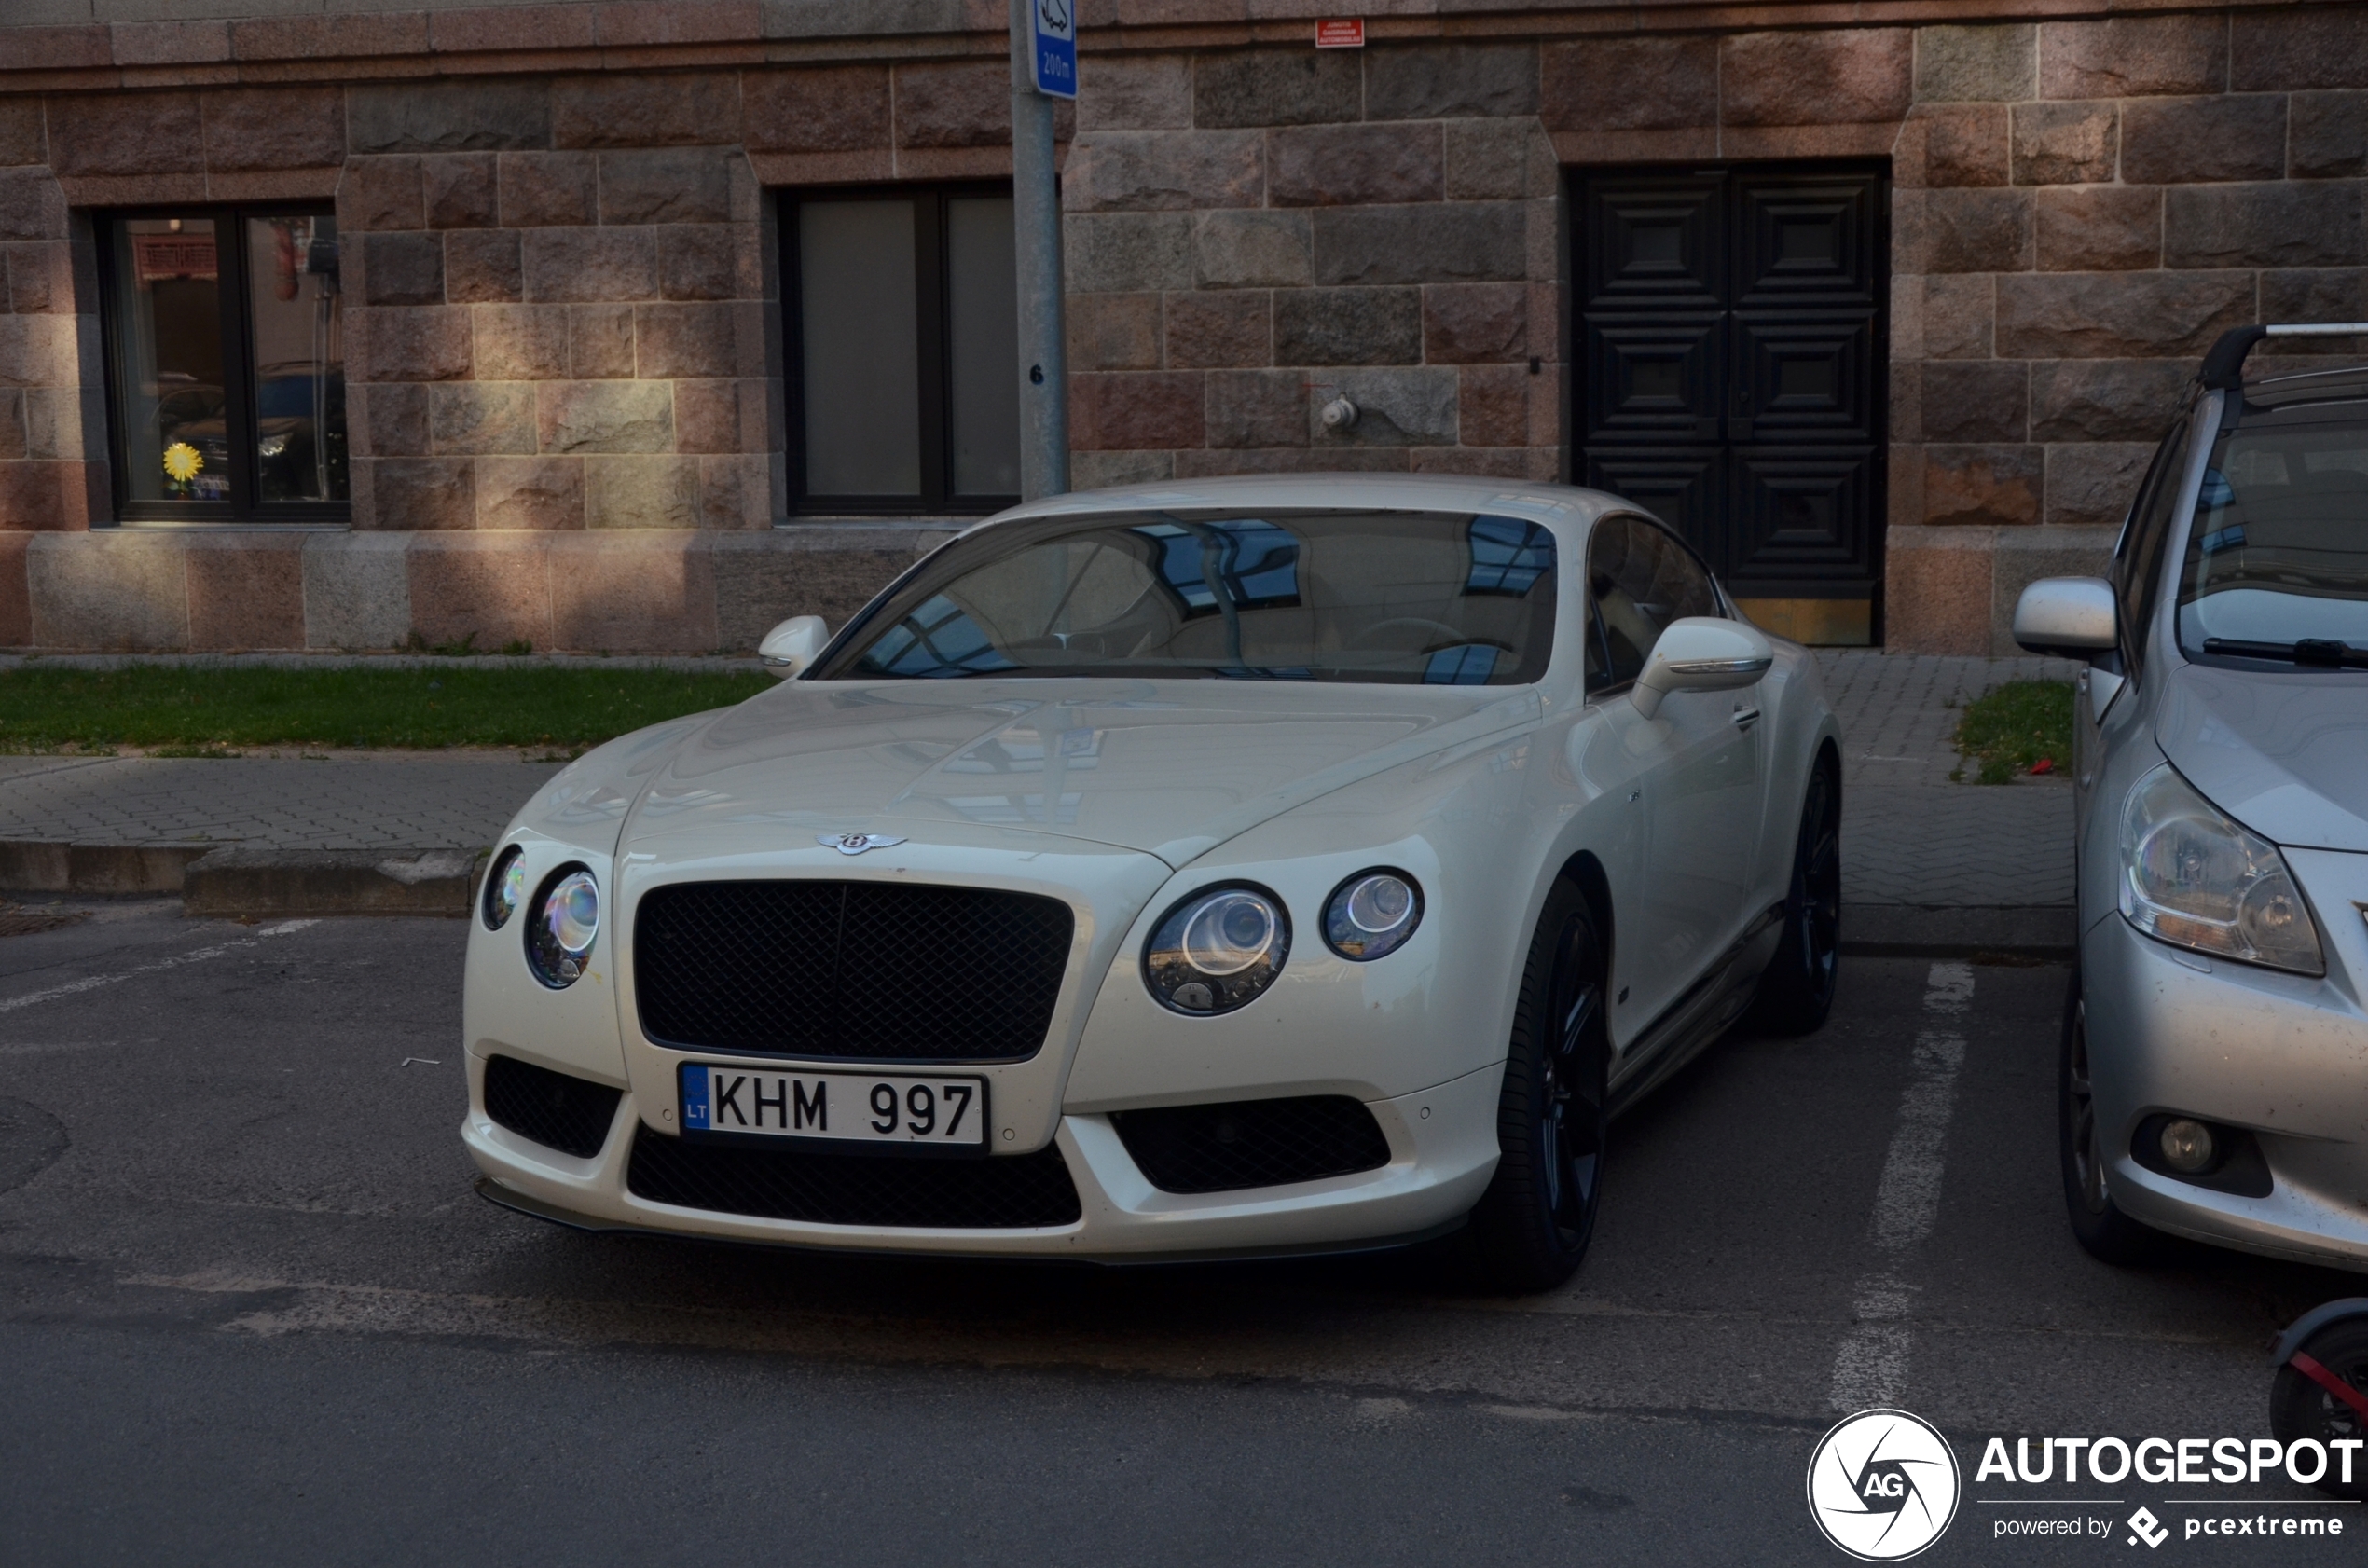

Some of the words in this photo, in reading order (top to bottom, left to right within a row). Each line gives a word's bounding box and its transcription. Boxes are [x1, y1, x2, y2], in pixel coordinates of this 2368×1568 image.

[687, 1104, 707, 1119] LT
[715, 1074, 827, 1131] KHM
[870, 1083, 973, 1135] 997
